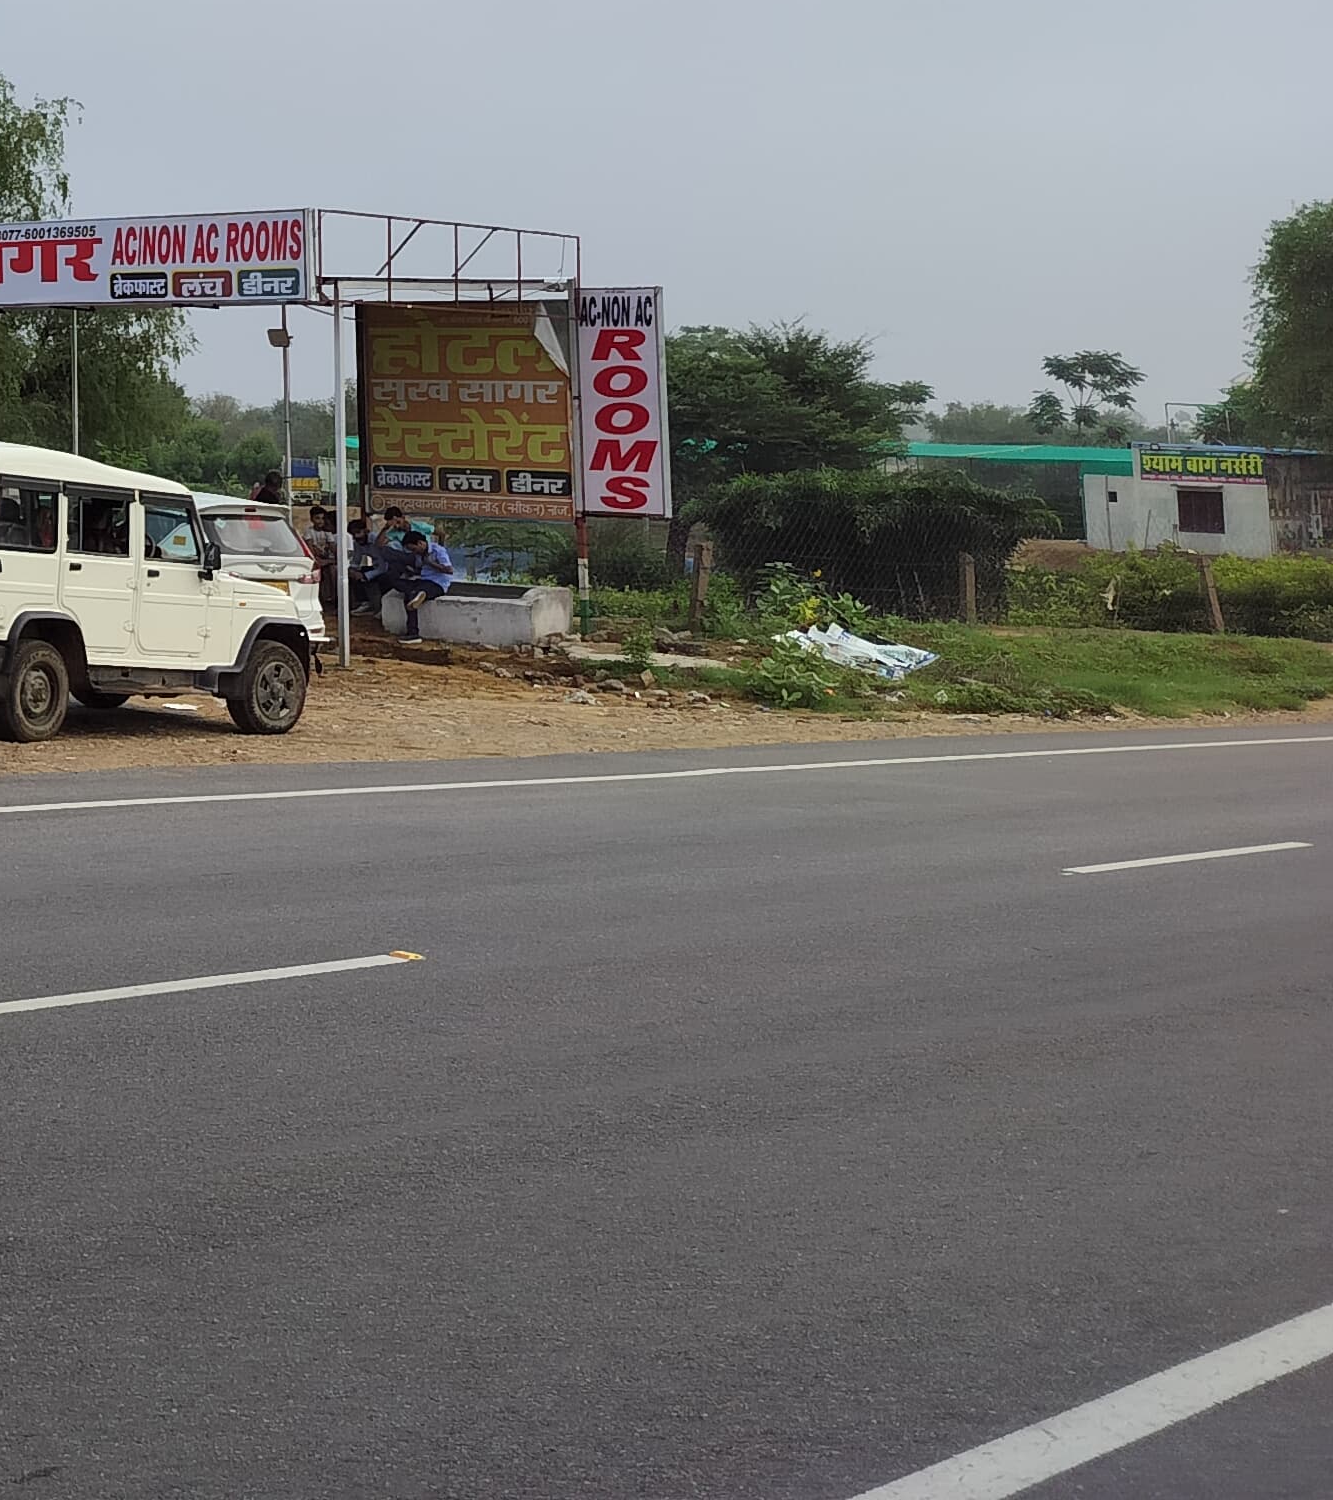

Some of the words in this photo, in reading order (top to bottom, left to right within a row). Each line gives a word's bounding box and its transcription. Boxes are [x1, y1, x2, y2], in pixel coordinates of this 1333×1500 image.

[192, 223, 219, 264] AC
[225, 219, 302, 262] ROOMS
[180, 272, 225, 296] लंच
[242, 271, 295, 295] डीनर
[580, 295, 631, 327] AC-NON
[634, 296, 653, 327] AC
[371, 379, 452, 411] सुख
[457, 380, 564, 404] सागर
[370, 406, 567, 464] रेस्टोरेंट
[589, 329, 658, 510] ROOMS
[1141, 454, 1183, 472] श्याम
[1185, 456, 1217, 474] बाग
[1218, 452, 1264, 476] नर्सरी
[446, 470, 493, 492] लंच
[510, 472, 567, 494] डीनर
